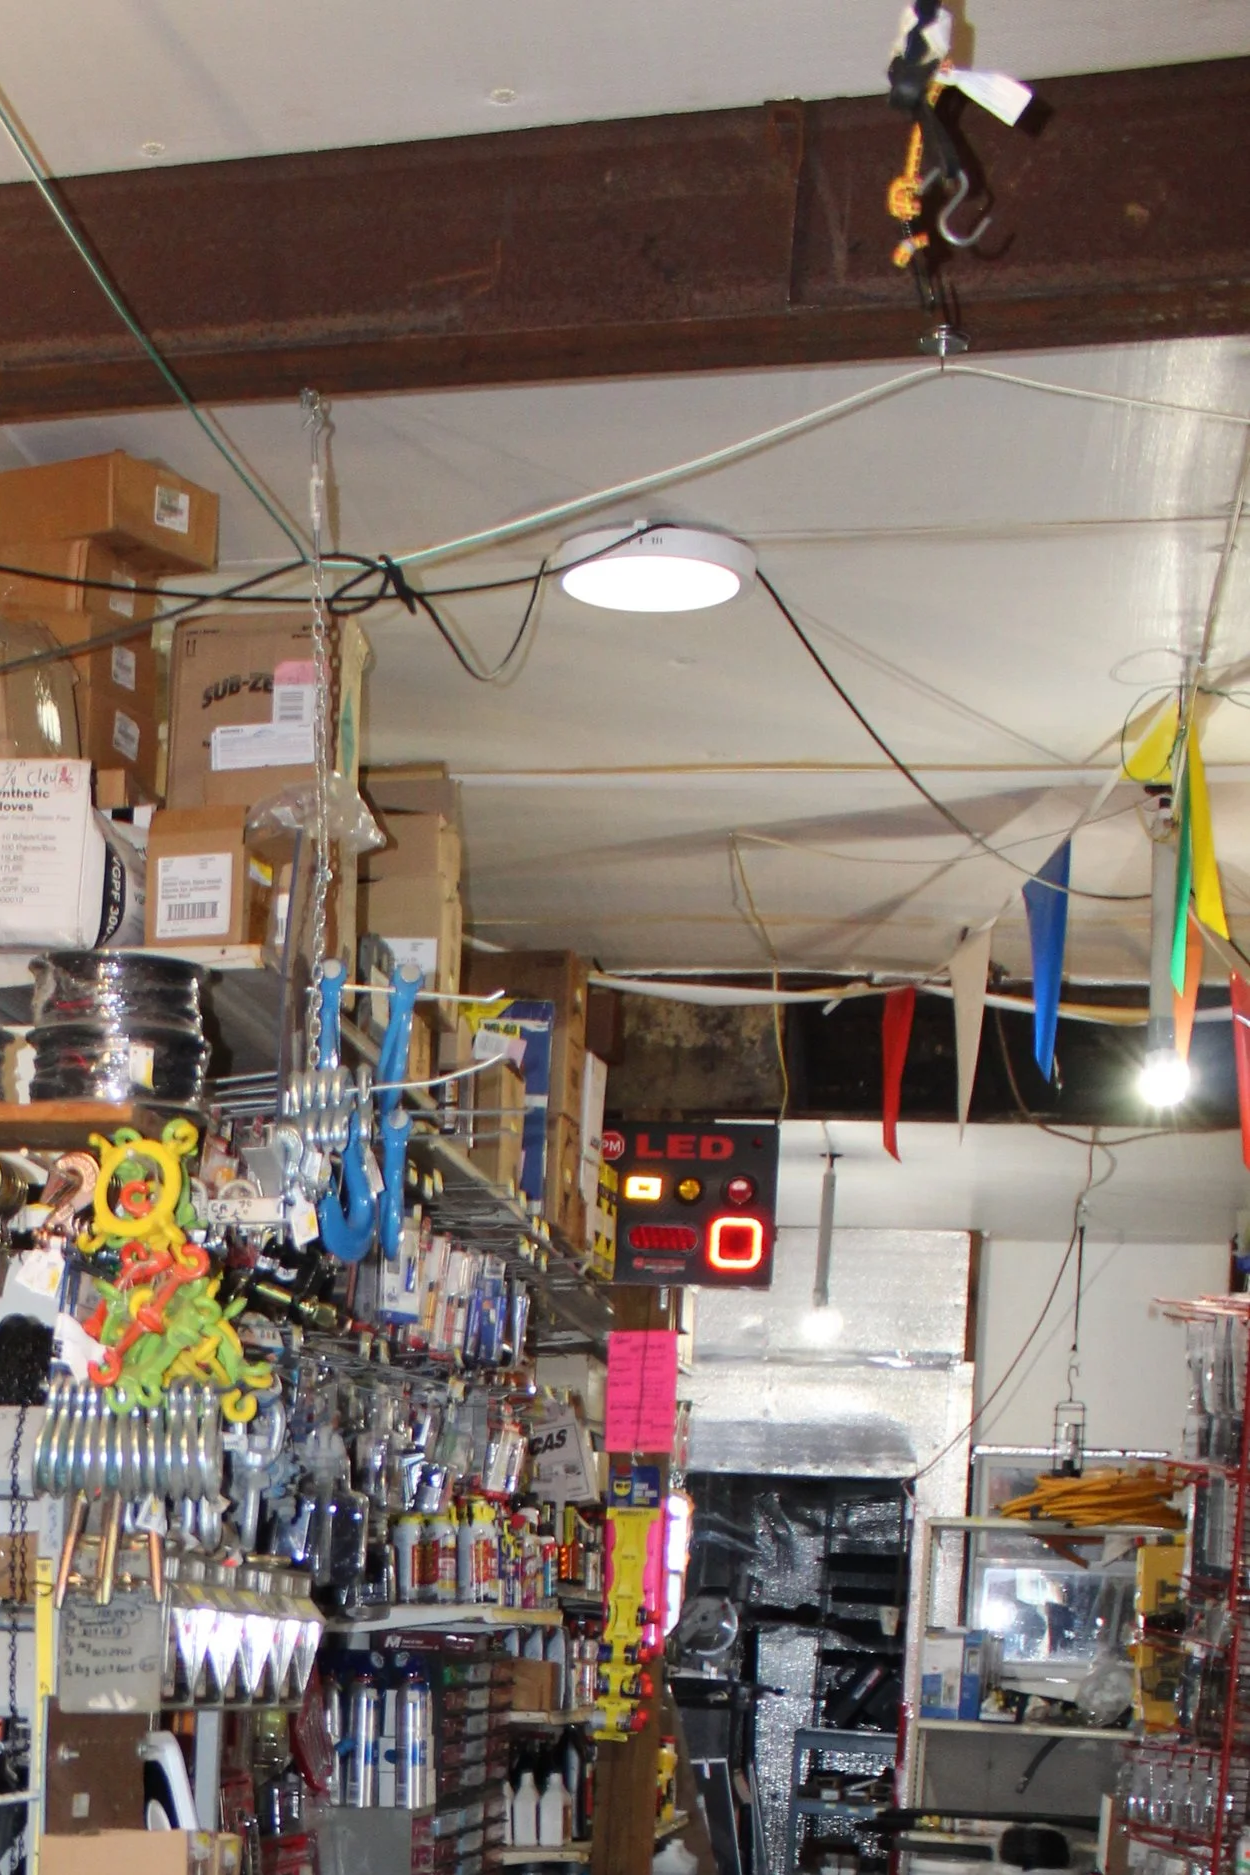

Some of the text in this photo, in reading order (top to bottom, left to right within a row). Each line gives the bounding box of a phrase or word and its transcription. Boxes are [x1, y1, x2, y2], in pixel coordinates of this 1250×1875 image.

[202, 671, 275, 708] SUB-ZE
[635, 1134, 735, 1160] LED
[530, 1429, 568, 1456] CAS
